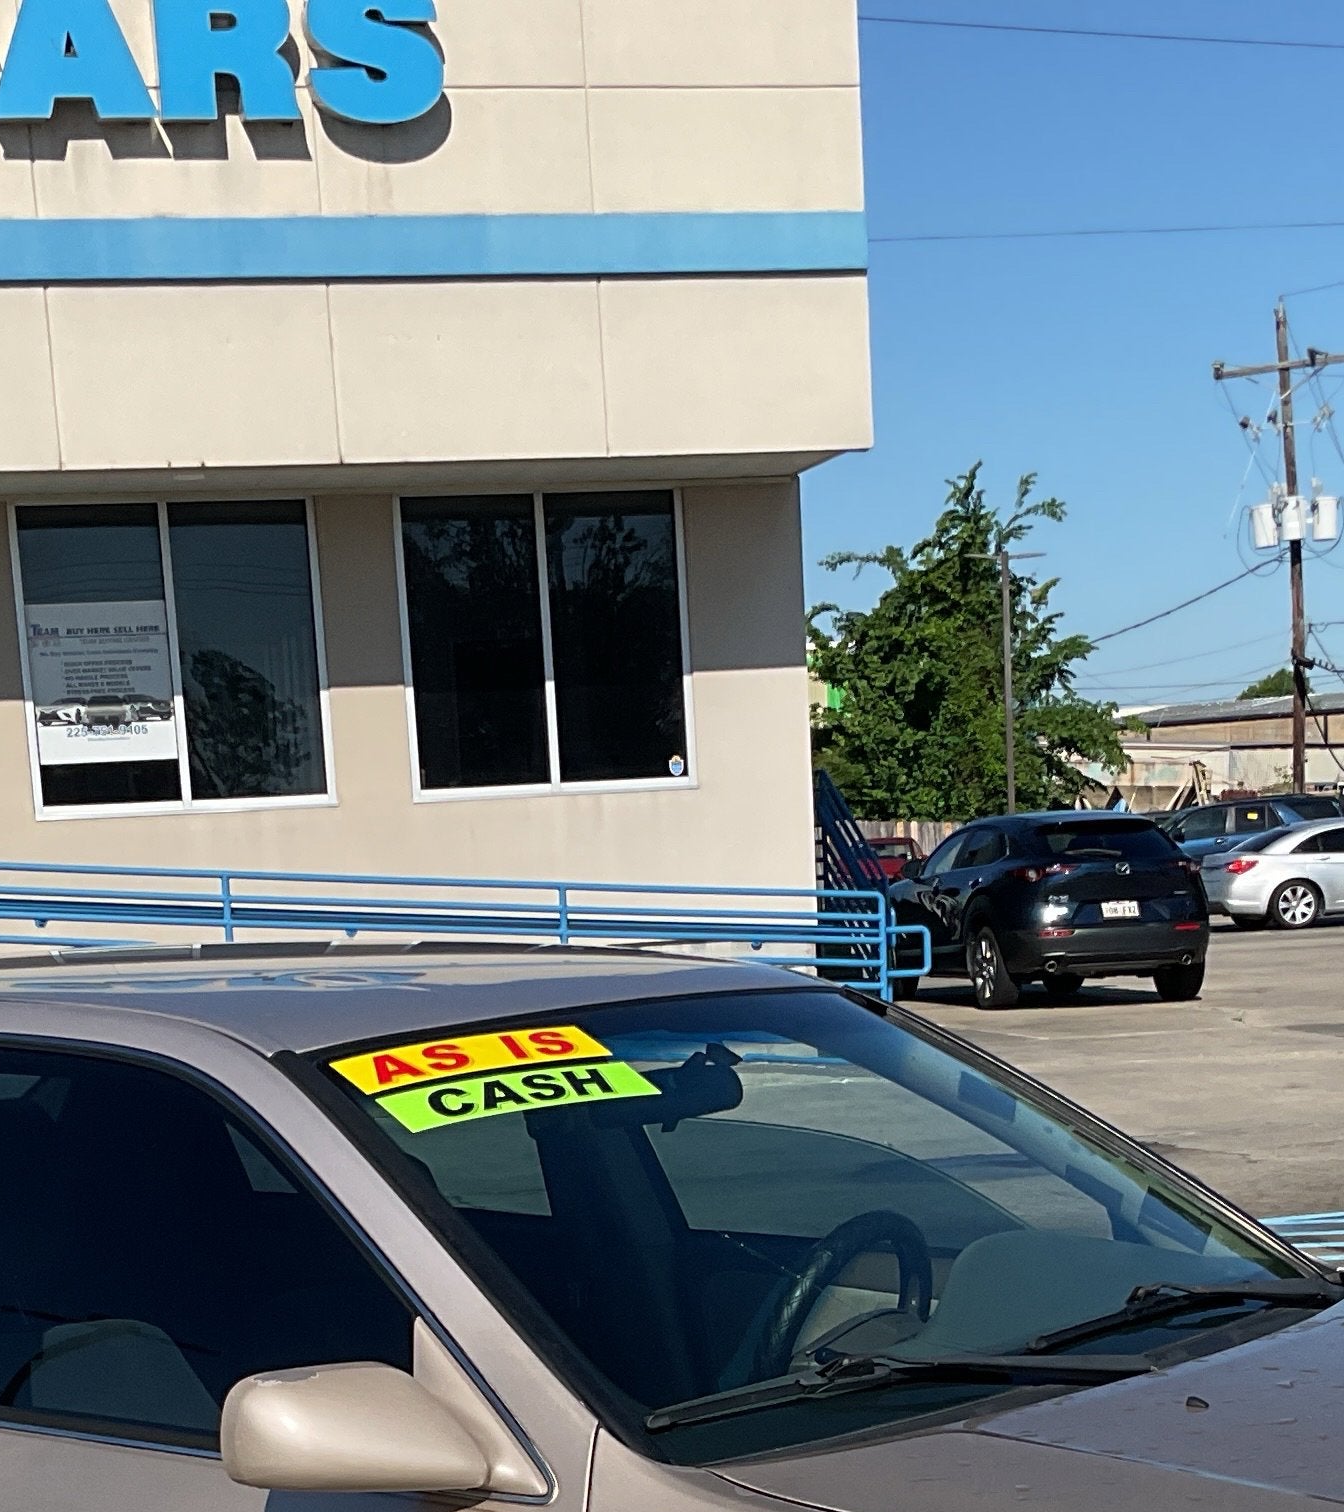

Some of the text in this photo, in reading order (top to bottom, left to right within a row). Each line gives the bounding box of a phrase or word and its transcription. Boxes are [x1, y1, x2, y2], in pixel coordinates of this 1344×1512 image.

[372, 1031, 575, 1085] AS IS
[427, 1067, 616, 1118] CASH
